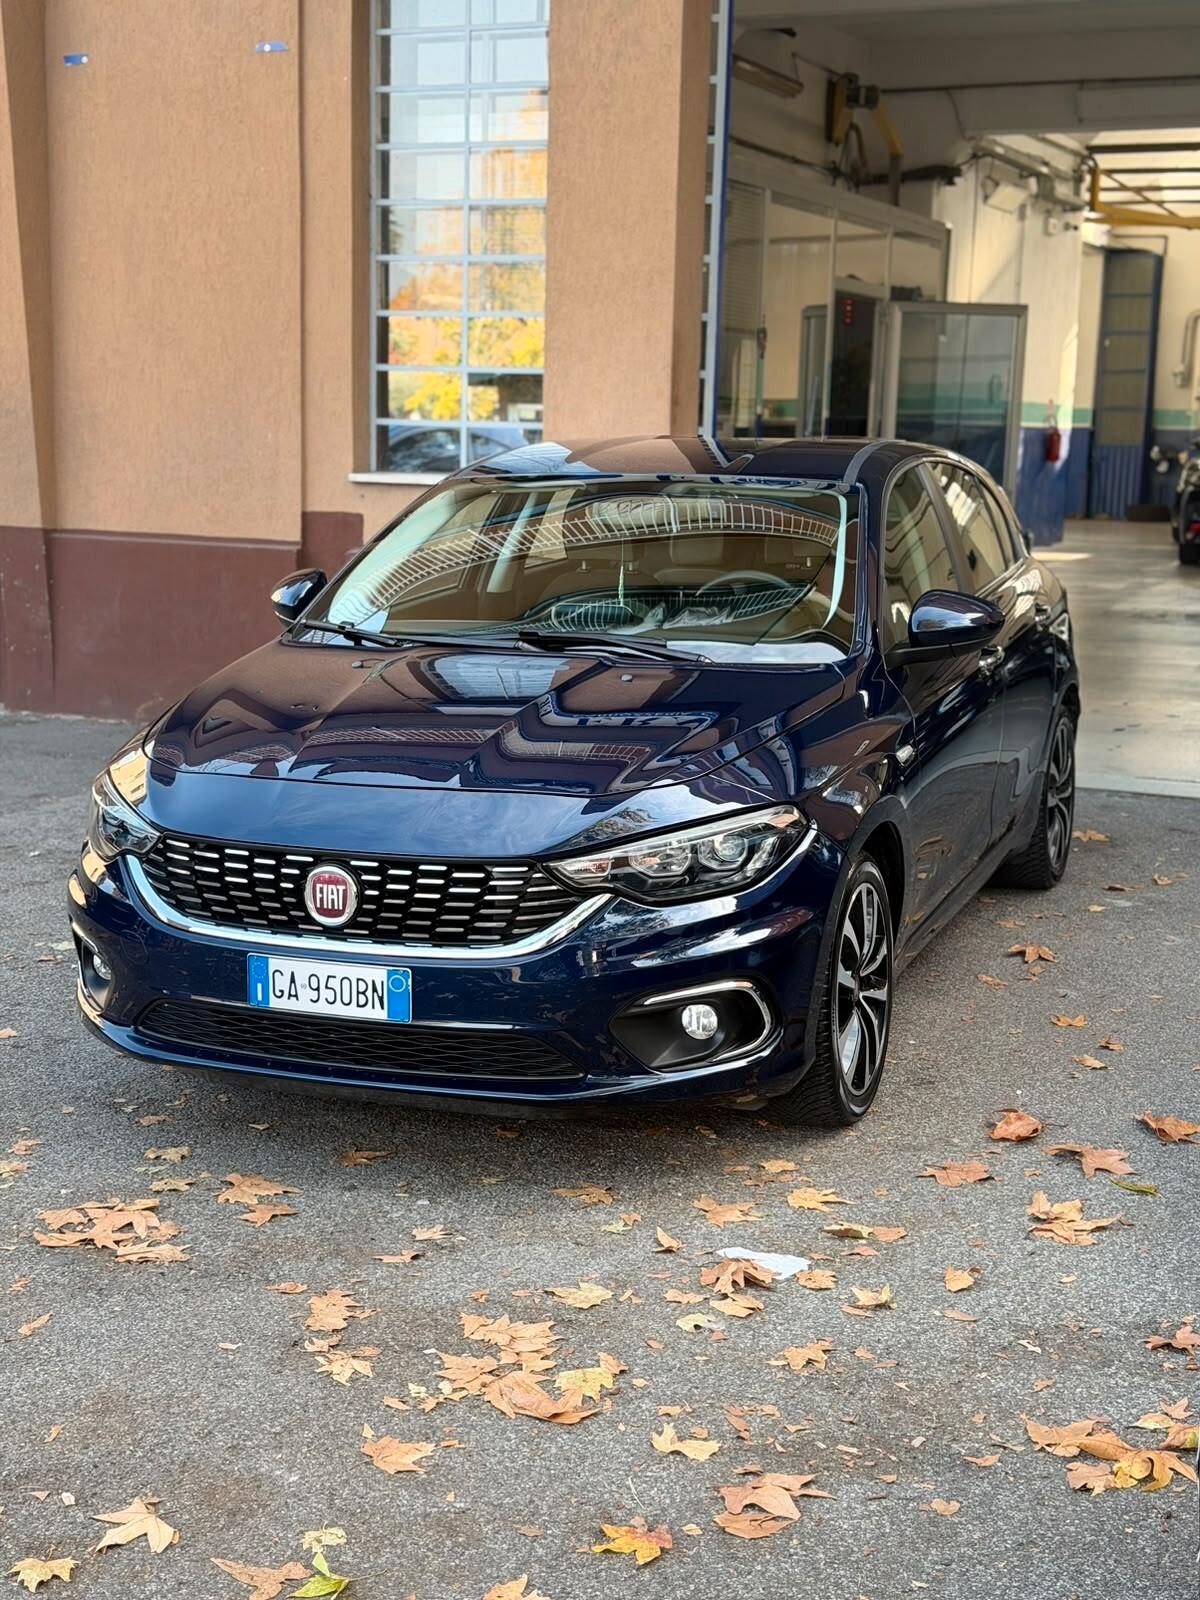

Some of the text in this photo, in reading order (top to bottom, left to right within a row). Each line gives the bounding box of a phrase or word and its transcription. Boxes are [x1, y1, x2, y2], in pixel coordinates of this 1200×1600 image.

[315, 883, 346, 910] FIAT
[271, 969, 385, 1010] GA 950BN
